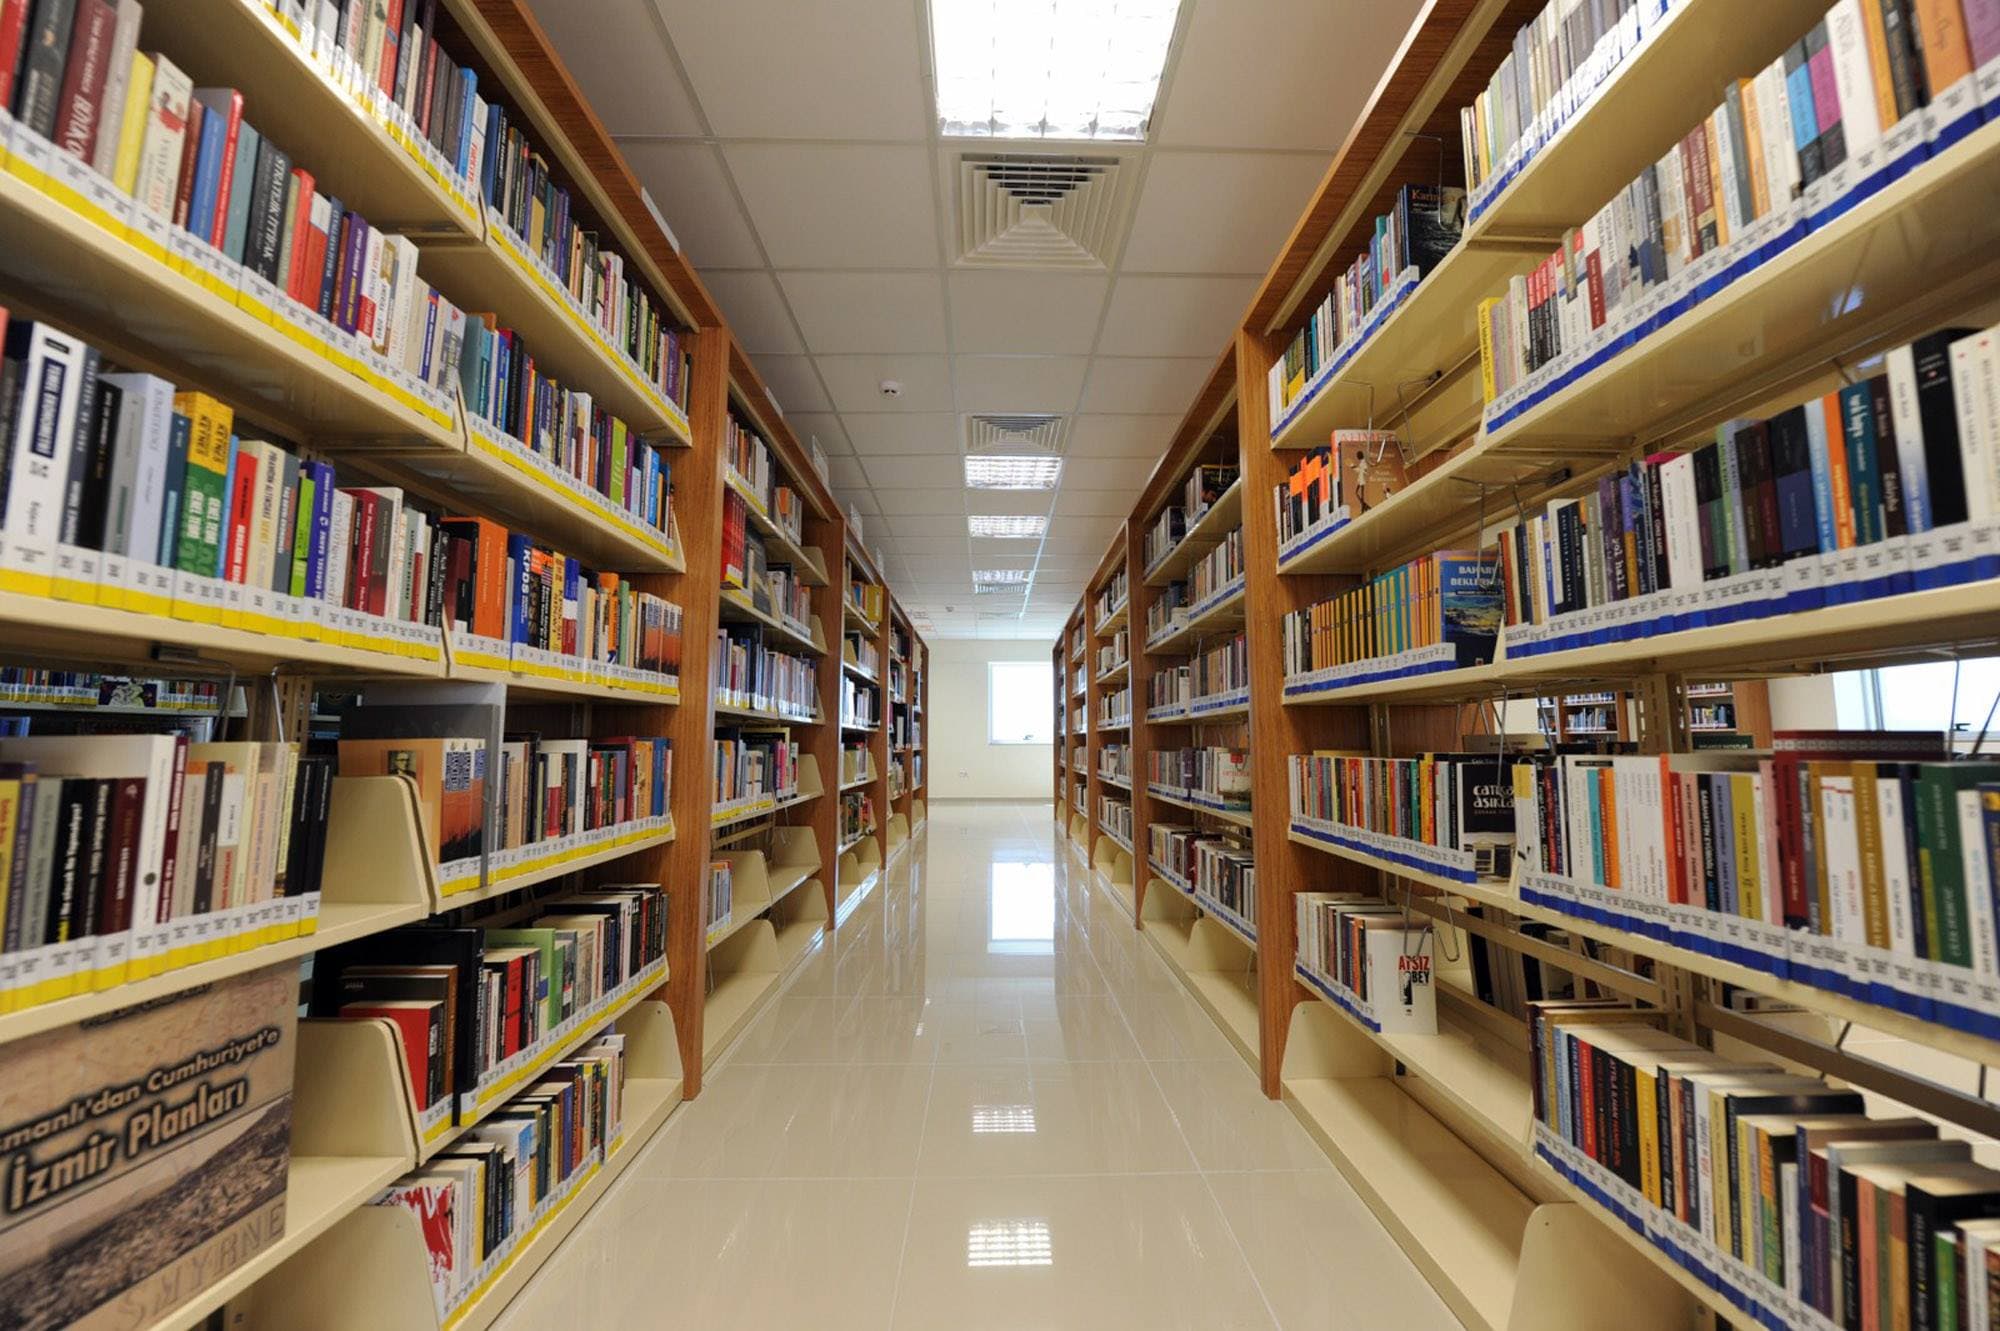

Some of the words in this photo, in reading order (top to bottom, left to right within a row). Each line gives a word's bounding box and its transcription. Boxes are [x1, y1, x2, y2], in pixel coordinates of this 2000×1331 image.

[269, 158, 286, 213] STRATEJİK
[262, 214, 280, 261] İTTİFAK
[628, 304, 638, 344] PETROL
[33, 392, 57, 456] EKONOMETRİ
[196, 415, 209, 457] KEYNES
[212, 423, 225, 464] KEYNES
[189, 490, 204, 514] GENEL
[206, 497, 221, 522] GENEL
[186, 515, 202, 539] TEORİ
[203, 522, 219, 545] TEORİ
[317, 531, 328, 554] SAHNE
[1611, 537, 1623, 556] yol
[521, 549, 532, 594] KPDS
[1615, 561, 1625, 591] hali
[1701, 790, 1712, 836] SABAHATTİN
[1703, 837, 1714, 877] EYÜBOĞLU
[0, 1083, 140, 1157] manlı'dan
[147, 1029, 279, 1092] Cumhuriyet'e
[10, 1134, 117, 1212] İzmir
[128, 1078, 247, 1158] Planları
